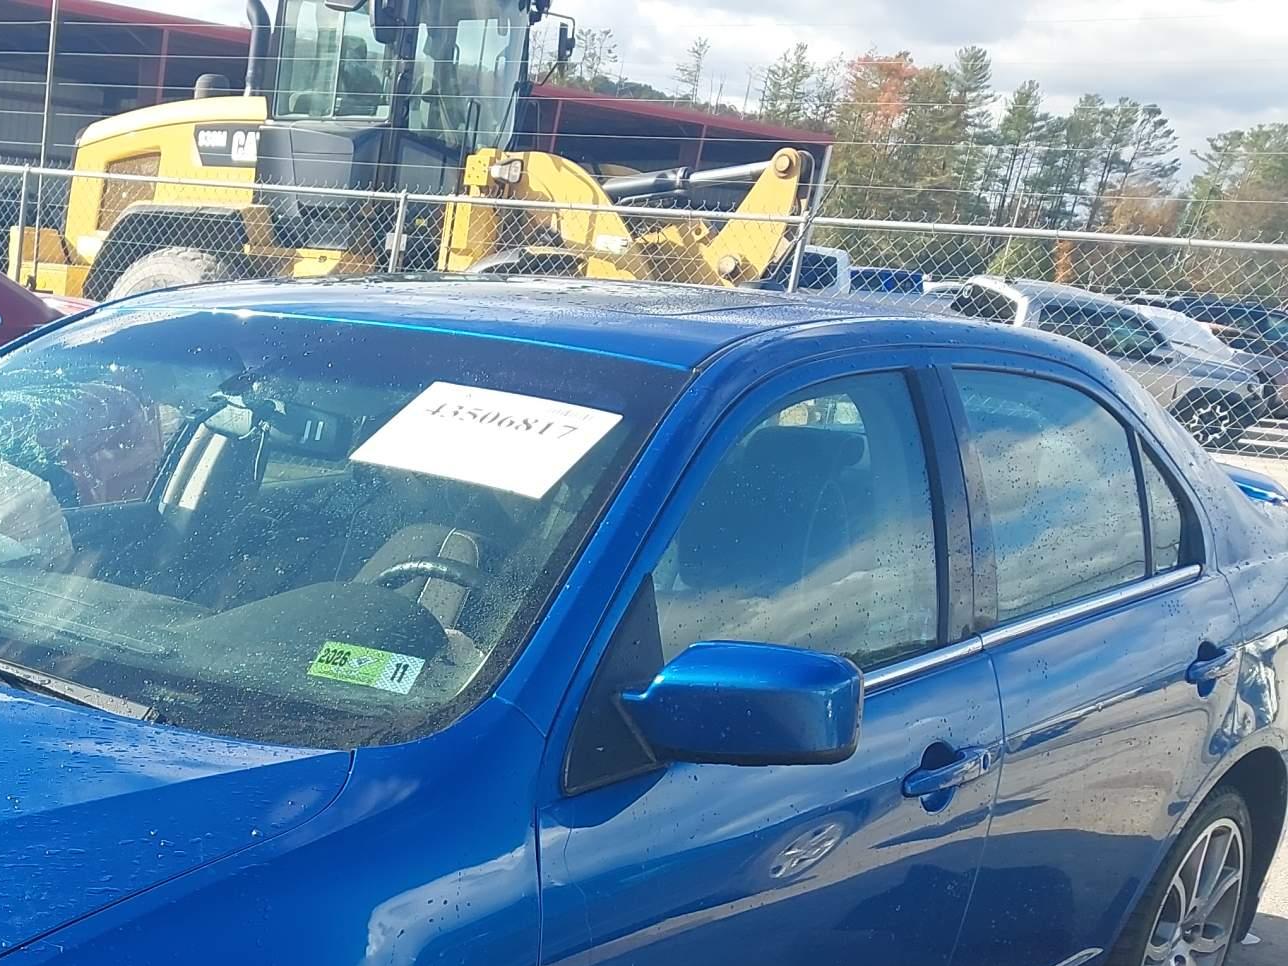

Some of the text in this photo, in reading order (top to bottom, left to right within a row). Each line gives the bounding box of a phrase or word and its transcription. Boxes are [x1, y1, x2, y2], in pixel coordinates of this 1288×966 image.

[231, 130, 261, 161] CA
[425, 402, 578, 439] 43506817
[318, 648, 351, 667] 2026
[390, 662, 410, 683] 11
